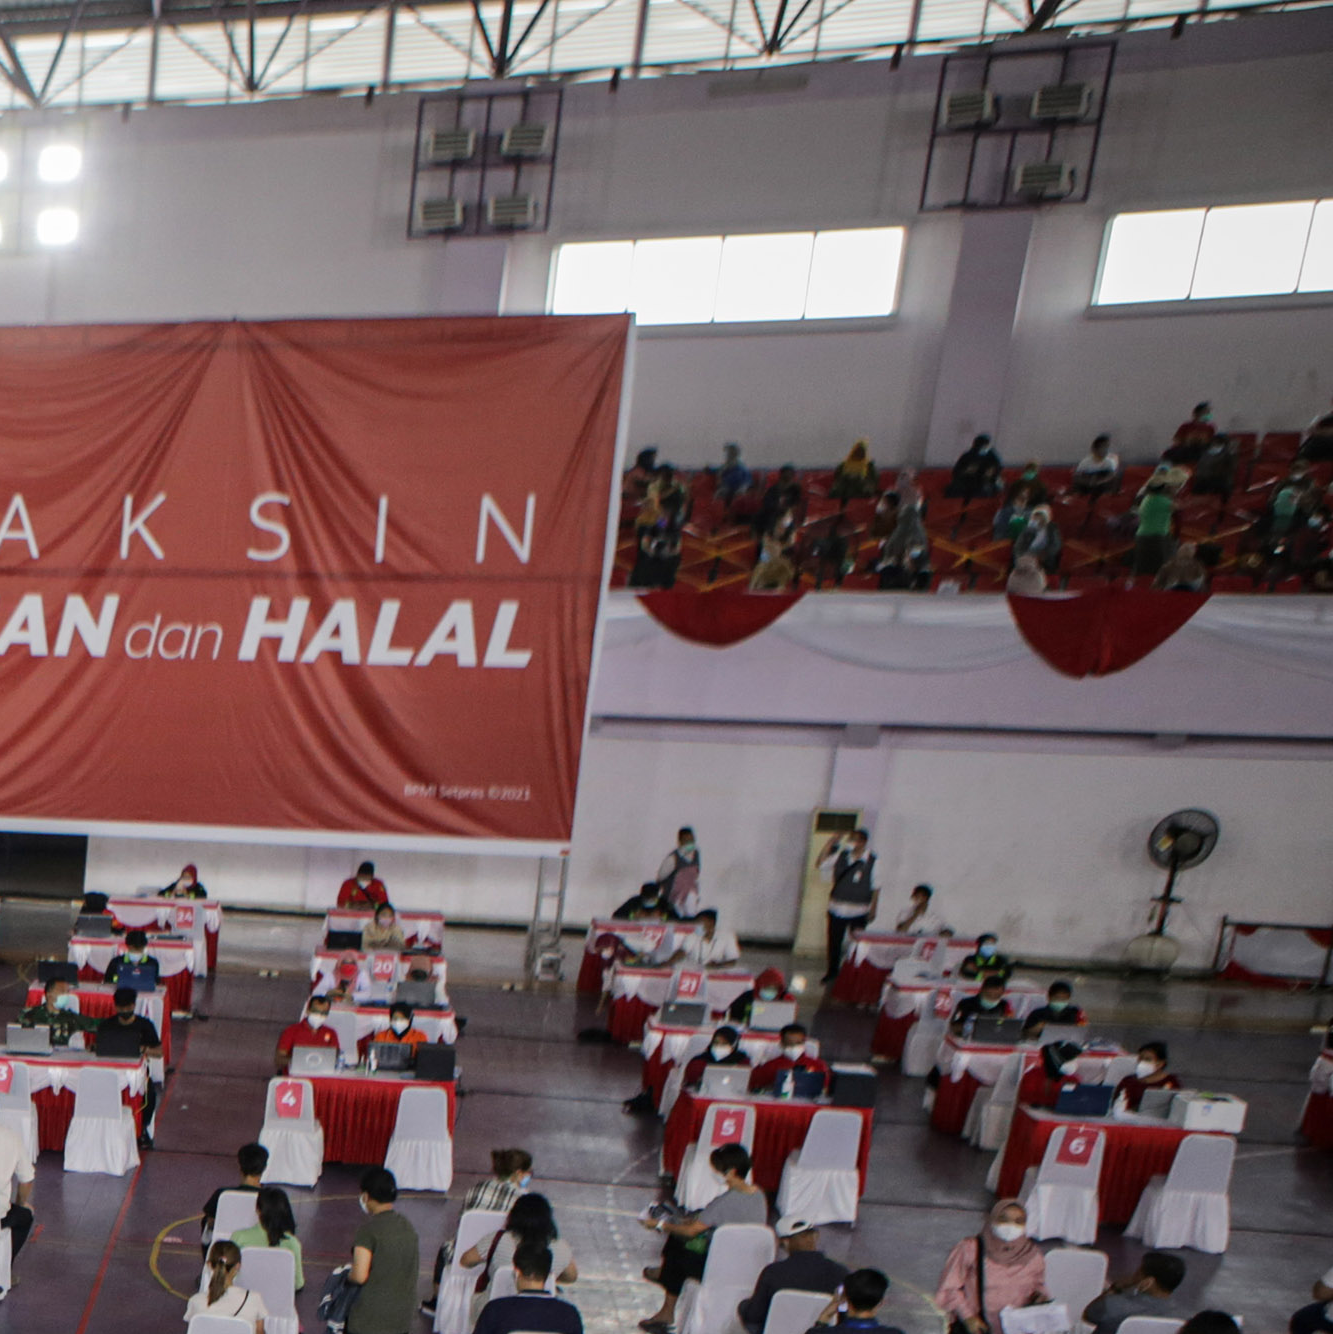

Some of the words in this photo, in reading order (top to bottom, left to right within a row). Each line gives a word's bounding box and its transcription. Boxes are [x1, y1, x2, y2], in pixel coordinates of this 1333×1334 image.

[124, 613, 223, 661] dan
[237, 595, 532, 669] HALAL
[374, 962, 393, 974] 20
[679, 979, 698, 993] 21
[281, 1089, 297, 1107] 4
[720, 1119, 735, 1136] 5
[1069, 1137, 1087, 1155] 6
